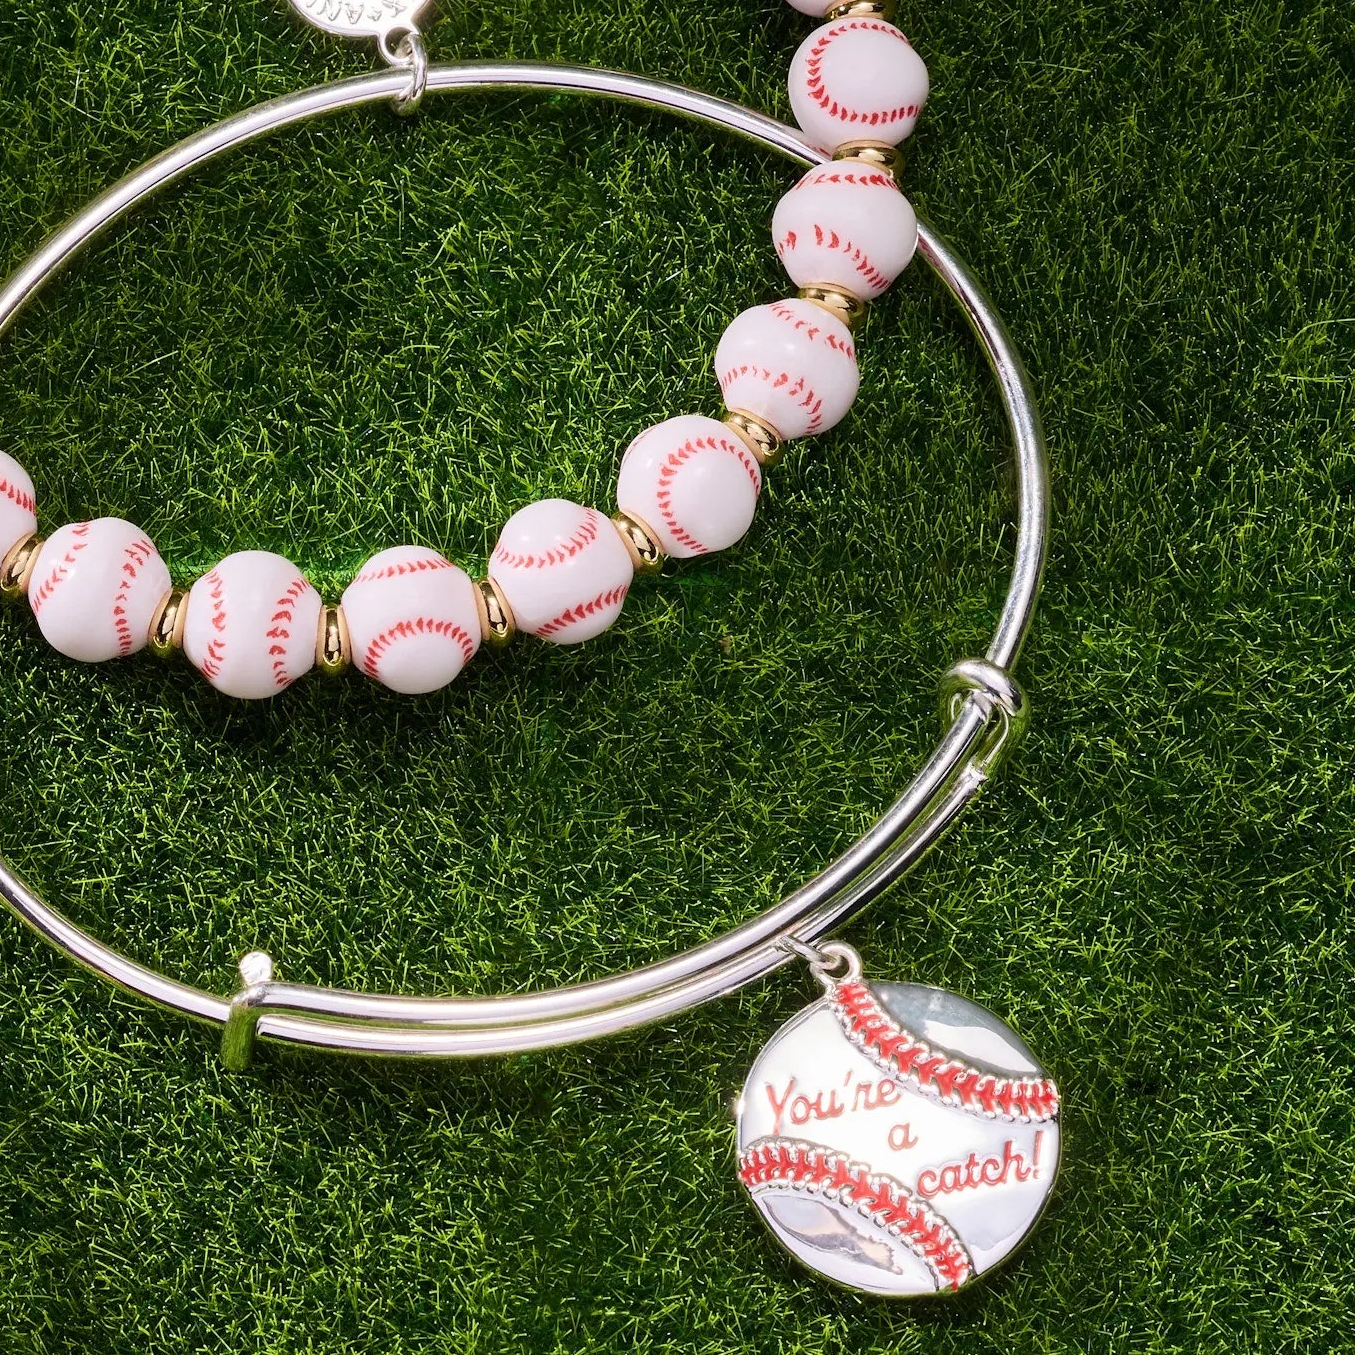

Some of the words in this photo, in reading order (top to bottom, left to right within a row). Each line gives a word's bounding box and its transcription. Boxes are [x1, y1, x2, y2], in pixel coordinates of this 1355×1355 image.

[764, 1070, 901, 1136] You're
[887, 1122, 919, 1152] a
[916, 1130, 1045, 1197] catch!
